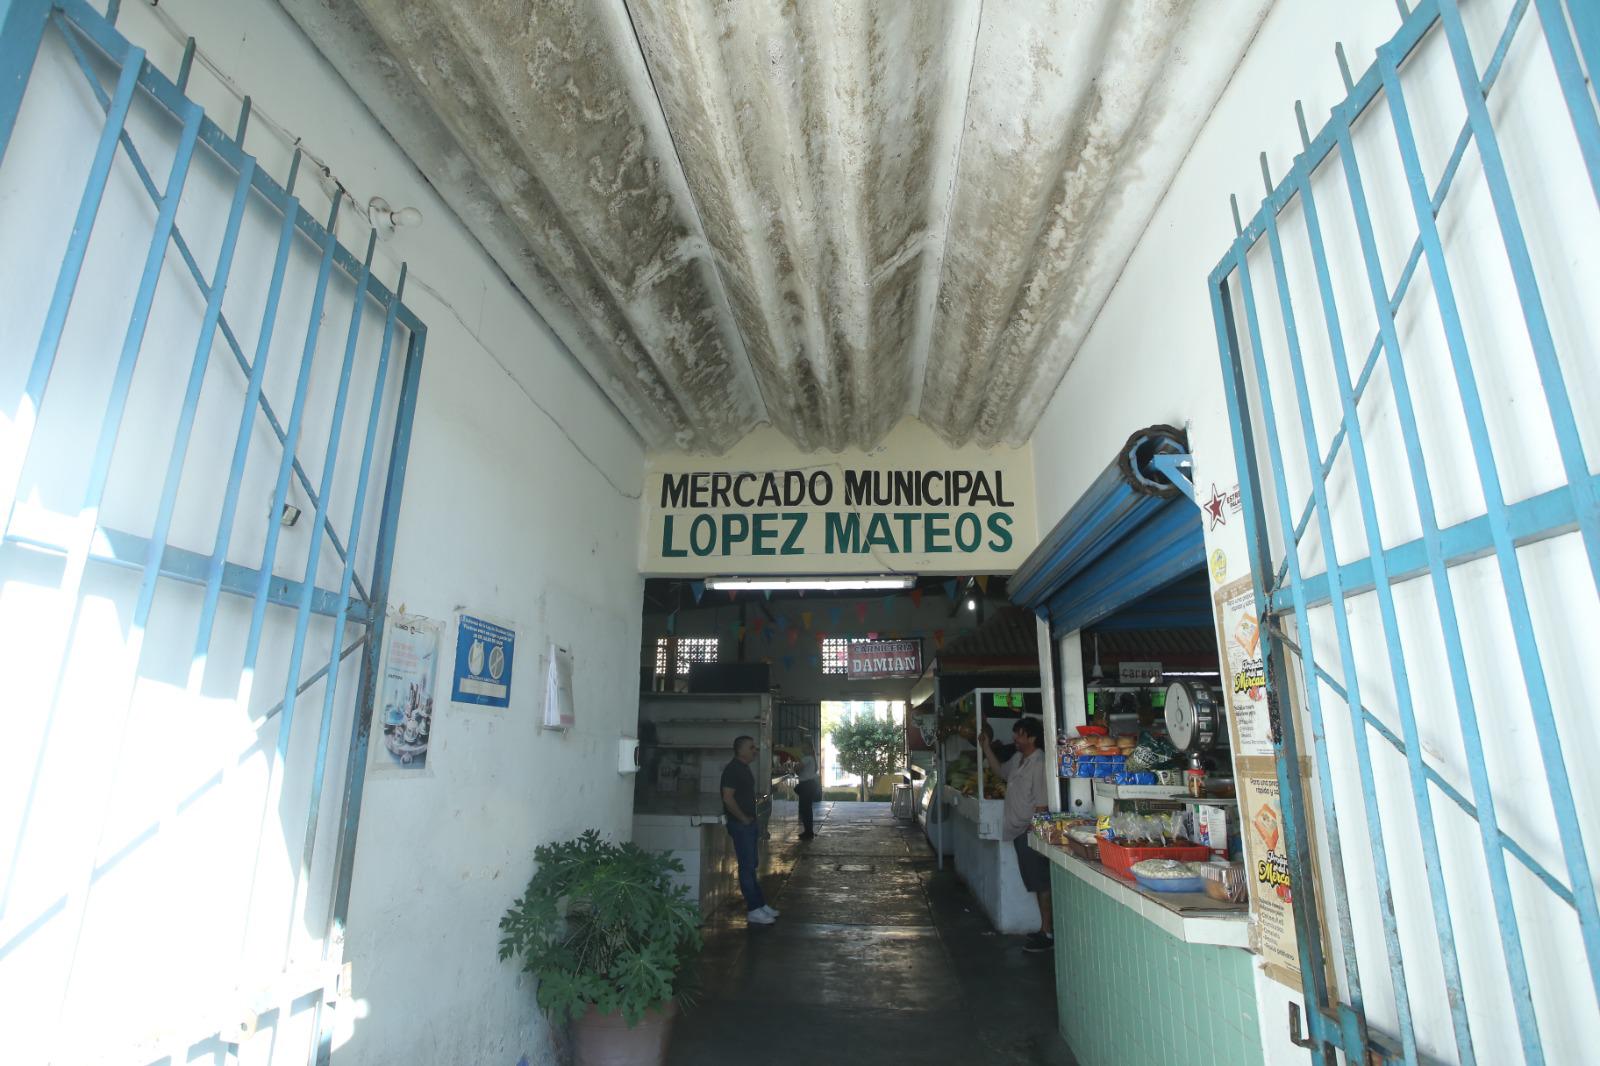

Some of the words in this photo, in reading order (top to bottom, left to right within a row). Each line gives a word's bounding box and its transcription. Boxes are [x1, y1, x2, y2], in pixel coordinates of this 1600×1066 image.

[661, 470, 834, 508] MERCADO
[845, 470, 1015, 507] MUNICIPAL
[661, 512, 809, 557] LOPEZ
[825, 512, 1014, 554] MATEOS
[852, 656, 916, 673] DAMIAN
[1234, 672, 1266, 694] Mercad
[1258, 860, 1290, 886] Merca
